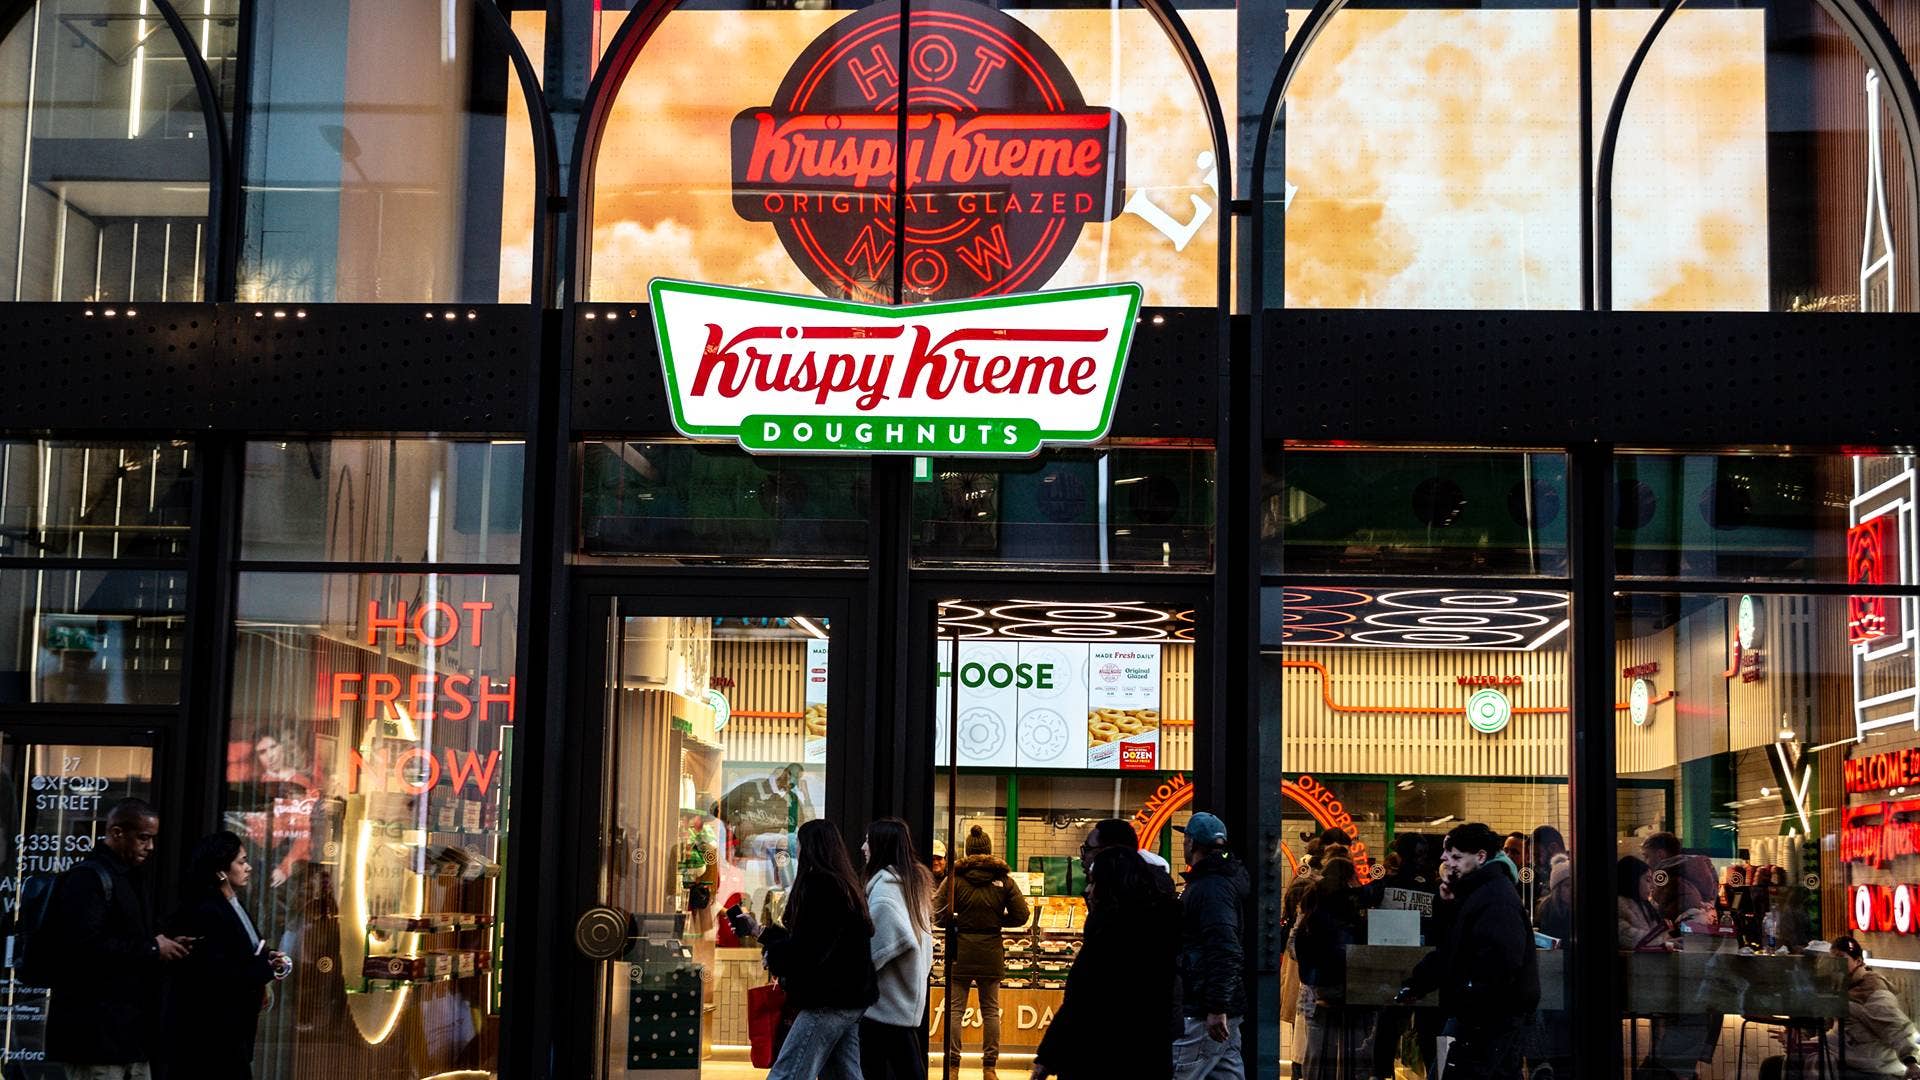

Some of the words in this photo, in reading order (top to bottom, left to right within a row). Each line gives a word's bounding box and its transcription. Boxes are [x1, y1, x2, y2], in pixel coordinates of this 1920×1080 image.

[847, 34, 1007, 100] HOT
[926, 112, 1111, 184] Kreme
[764, 192, 938, 214] ORIGINAL
[958, 192, 1093, 214] GLAZED
[845, 223, 1013, 293] NOW
[690, 322, 905, 412] Krispy
[898, 323, 1109, 401] Kreme
[762, 420, 1019, 446] DOUGHNUTS
[367, 600, 494, 648] HOT
[1114, 651, 1136, 659] Fresh
[936, 661, 1054, 689] HOOSE
[1456, 675, 1522, 686] WATERLOO
[331, 672, 516, 722] FRESH
[63, 757, 81, 772] 27
[348, 747, 501, 797] NOW
[1122, 751, 1153, 760] DOZEN
[1844, 751, 1908, 793] WELCOME
[31, 775, 109, 791] OXFORD
[1144, 772, 1187, 812] NOW
[36, 794, 103, 810] STREET
[1298, 774, 1360, 841] OXFORD
[1392, 889, 1408, 902] LOS
